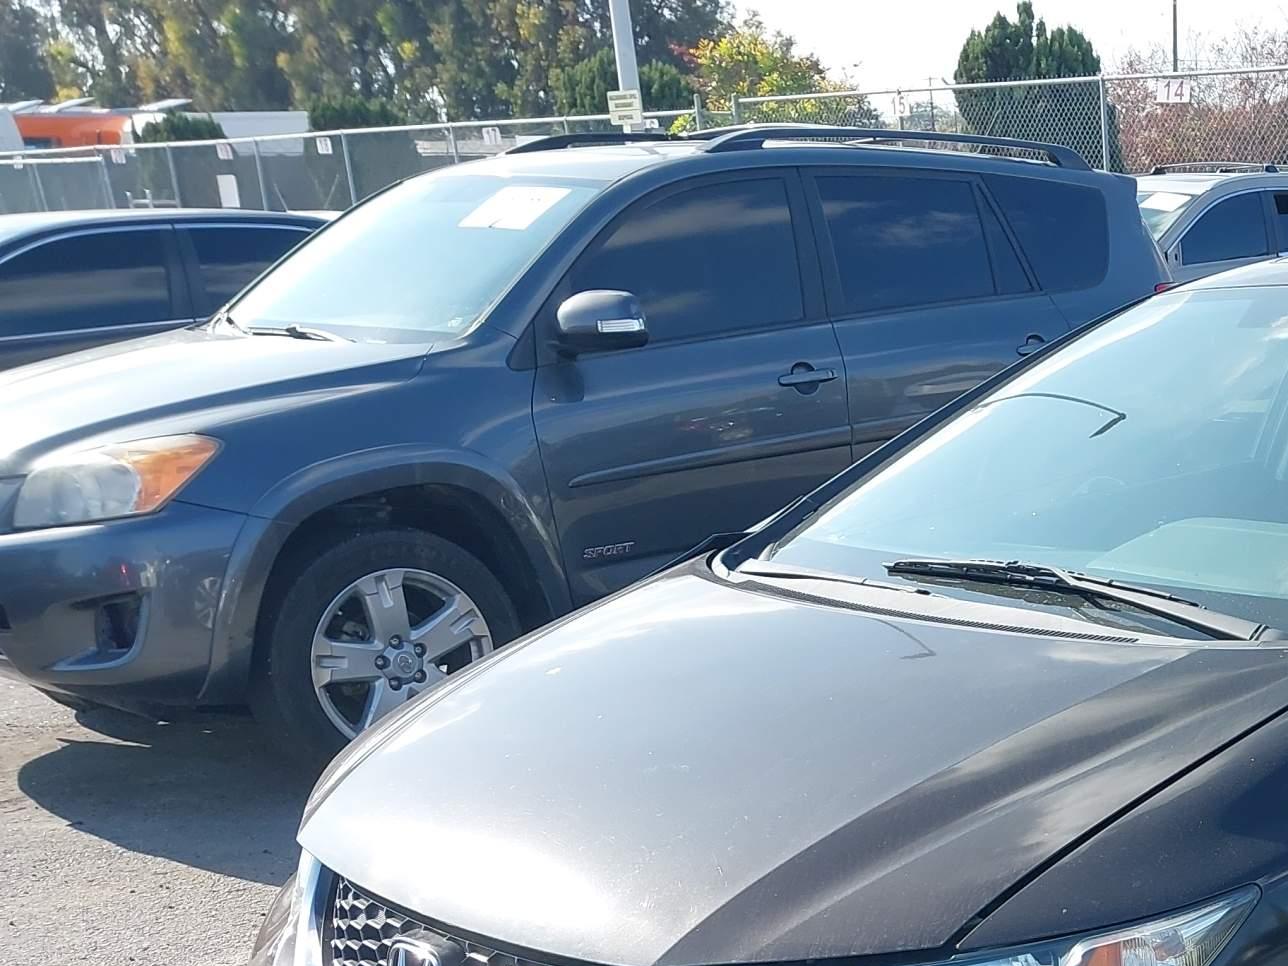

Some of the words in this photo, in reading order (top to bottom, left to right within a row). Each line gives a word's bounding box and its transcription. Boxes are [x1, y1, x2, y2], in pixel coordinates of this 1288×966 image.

[1163, 80, 1185, 101] 14
[891, 95, 906, 115] 15
[583, 541, 635, 558] SPORT
